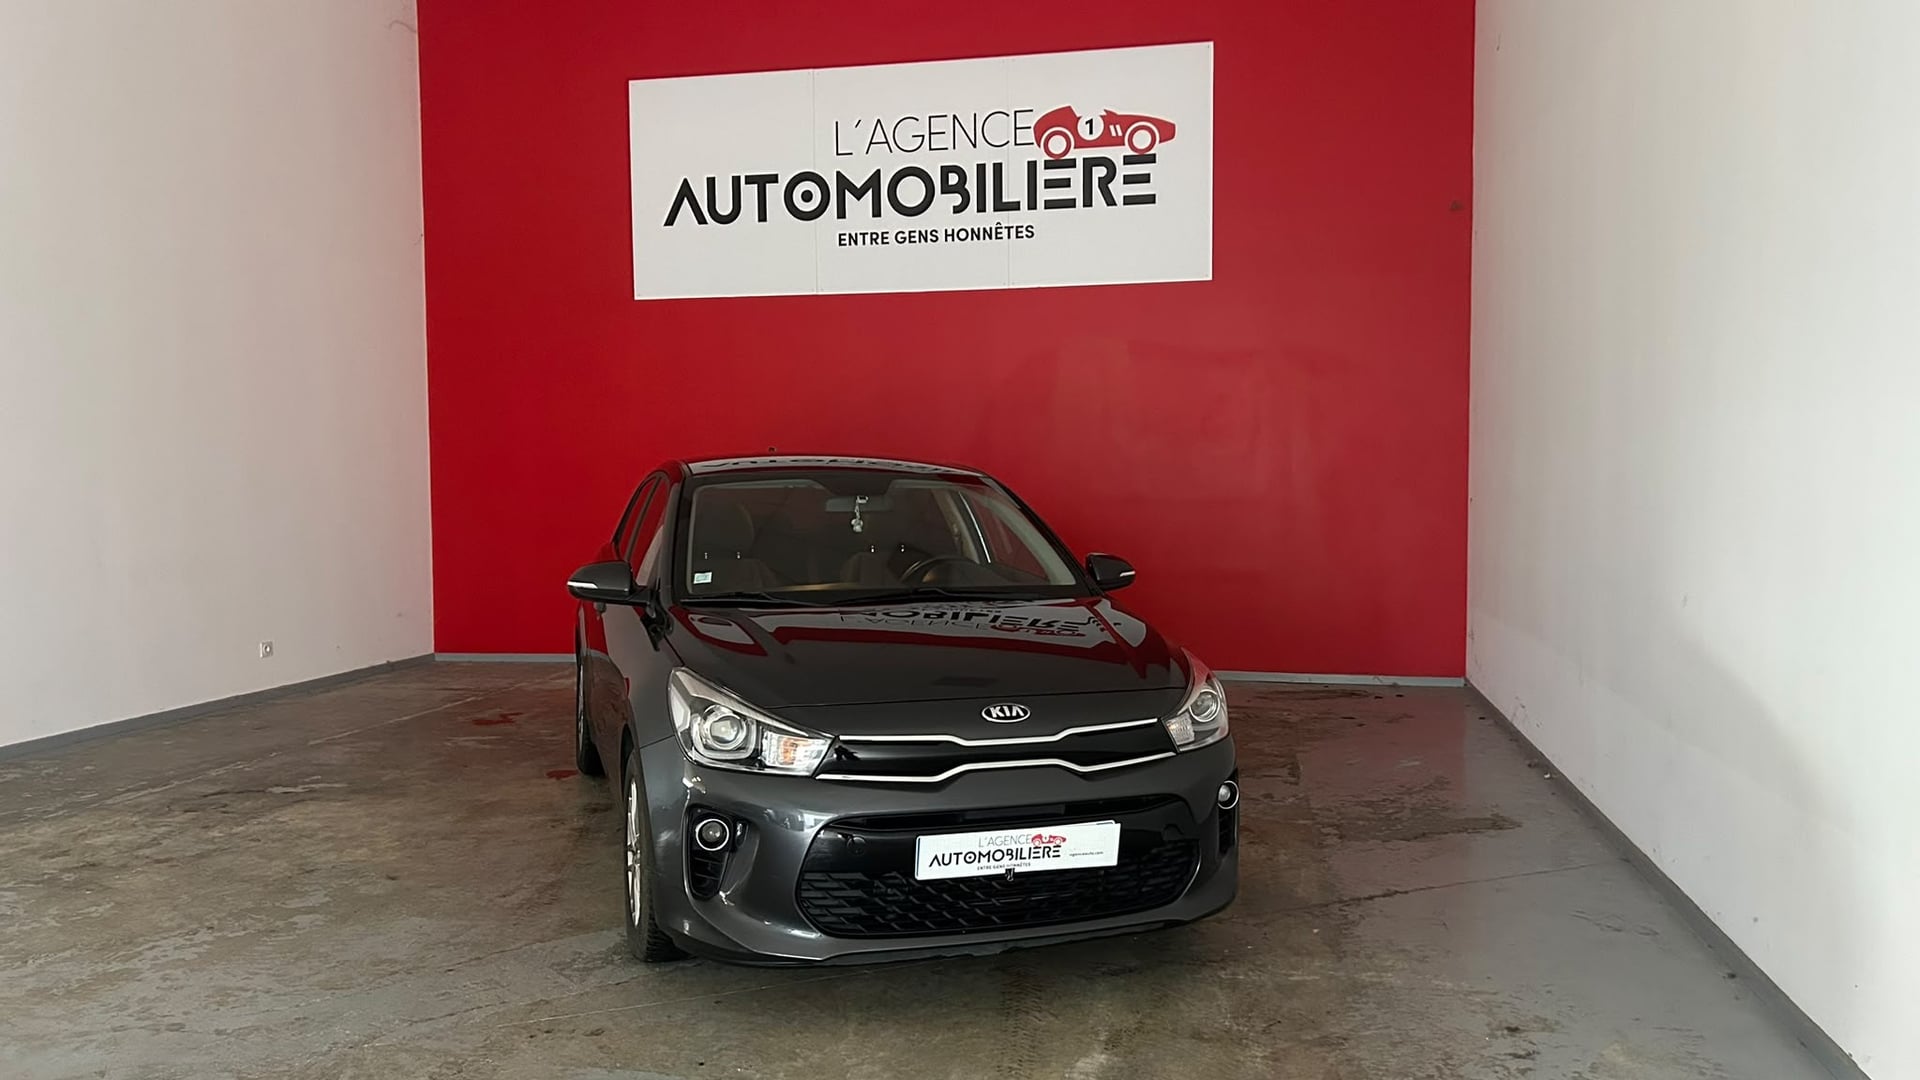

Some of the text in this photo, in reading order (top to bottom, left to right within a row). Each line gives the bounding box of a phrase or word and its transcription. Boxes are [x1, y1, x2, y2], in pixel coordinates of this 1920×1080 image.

[835, 109, 1034, 156] L'AGENCE
[1085, 118, 1094, 135] 1
[838, 221, 1035, 247] ENTRE GENS HONNÊTES
[988, 704, 1026, 719] KIA
